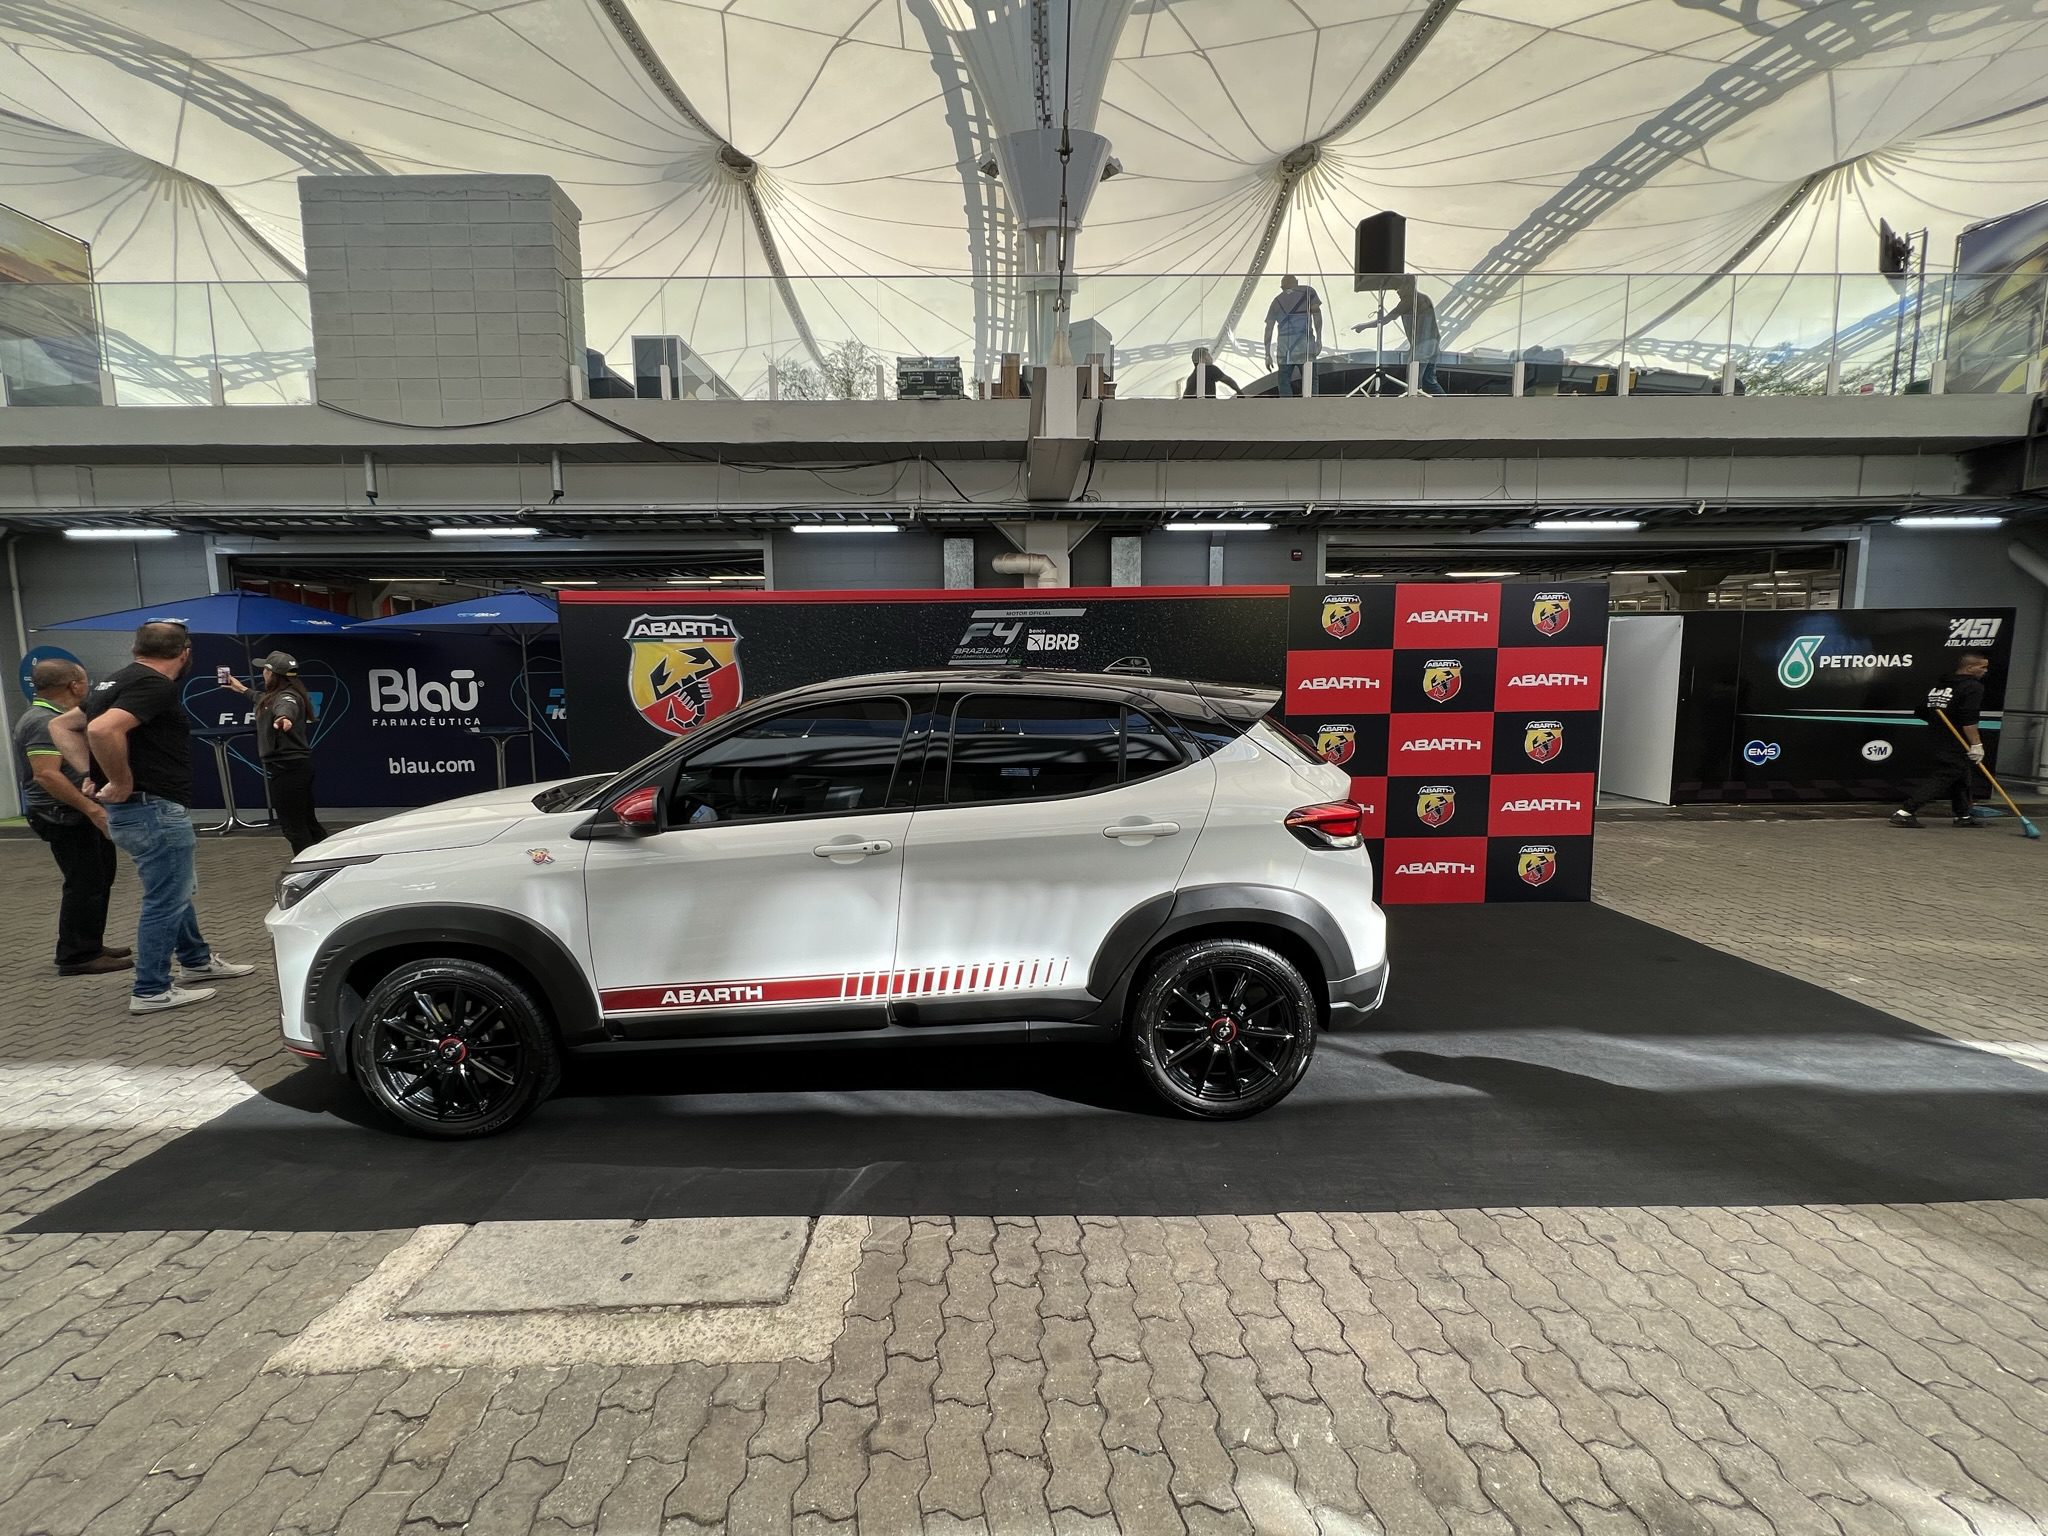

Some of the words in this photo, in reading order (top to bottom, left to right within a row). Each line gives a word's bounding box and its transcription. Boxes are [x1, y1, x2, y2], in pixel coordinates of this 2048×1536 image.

[1406, 610, 1489, 623] ABARTH
[633, 621, 729, 636] ABARTH
[960, 622, 1024, 646] F4
[1949, 618, 2003, 639] A51
[1044, 633, 1080, 651] BRB
[1819, 654, 1913, 668] PETRONAS
[1298, 676, 1380, 690] ABARTH
[1507, 673, 1588, 687] ABARTH
[372, 716, 481, 727] FARMACÊUTICA
[1400, 738, 1481, 751] ABARTH
[1748, 748, 1776, 756] EMS
[388, 757, 476, 775] blau.com
[1500, 799, 1581, 812] ABARTH
[1395, 862, 1475, 875] ABARTH
[660, 985, 763, 1005] ABARTH
